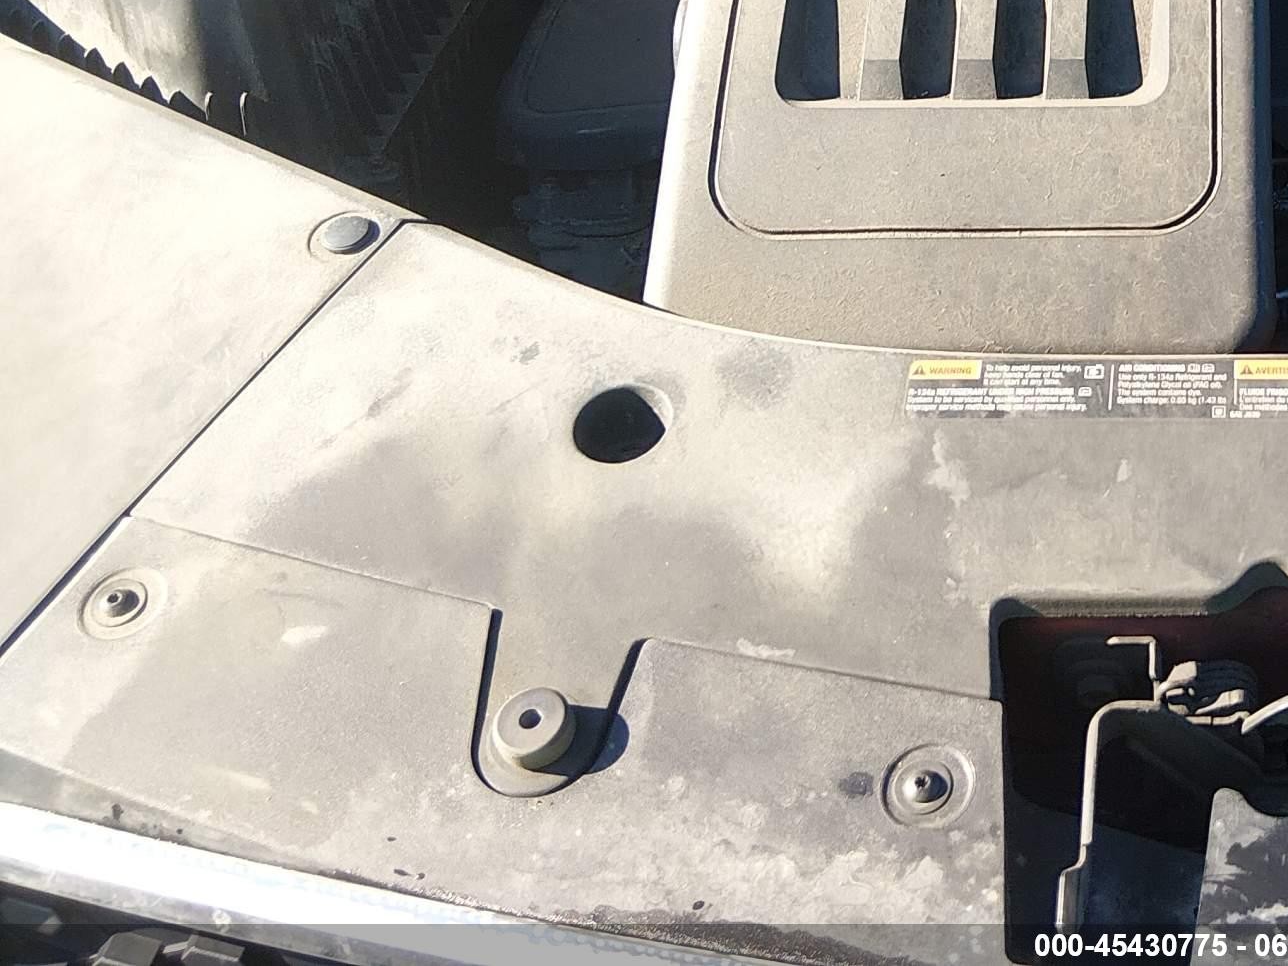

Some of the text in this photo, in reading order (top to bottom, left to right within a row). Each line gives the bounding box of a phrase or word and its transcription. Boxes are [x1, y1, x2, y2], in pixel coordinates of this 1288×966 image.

[929, 366, 972, 374] WARNING
[1031, 364, 1060, 372] personal
[1133, 364, 1186, 372] CONDITIONING
